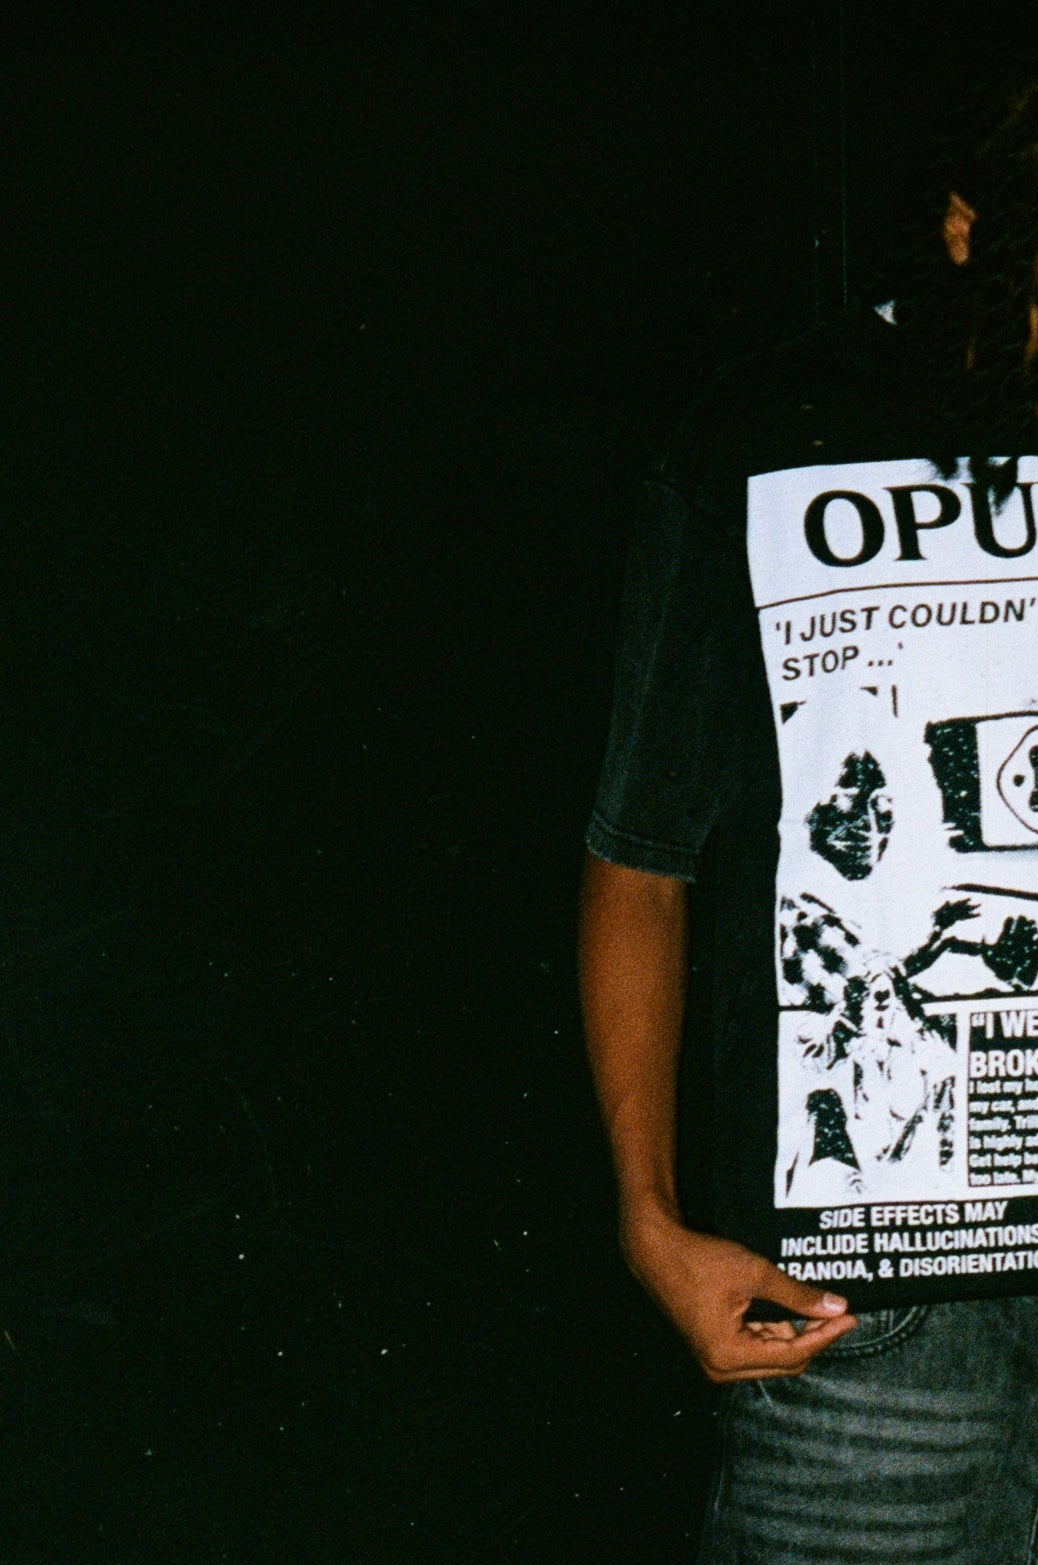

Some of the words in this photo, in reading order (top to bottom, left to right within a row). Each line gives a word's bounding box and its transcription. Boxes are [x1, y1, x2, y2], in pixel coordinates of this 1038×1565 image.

[799, 605, 880, 642] JUST
[782, 645, 860, 681] STOP
[819, 1208, 866, 1230] SIDE
[870, 1204, 960, 1227] EFFECTS
[964, 1200, 1009, 1223] MAY
[780, 1233, 869, 1258] INCLUDE
[877, 1258, 895, 1279] &
